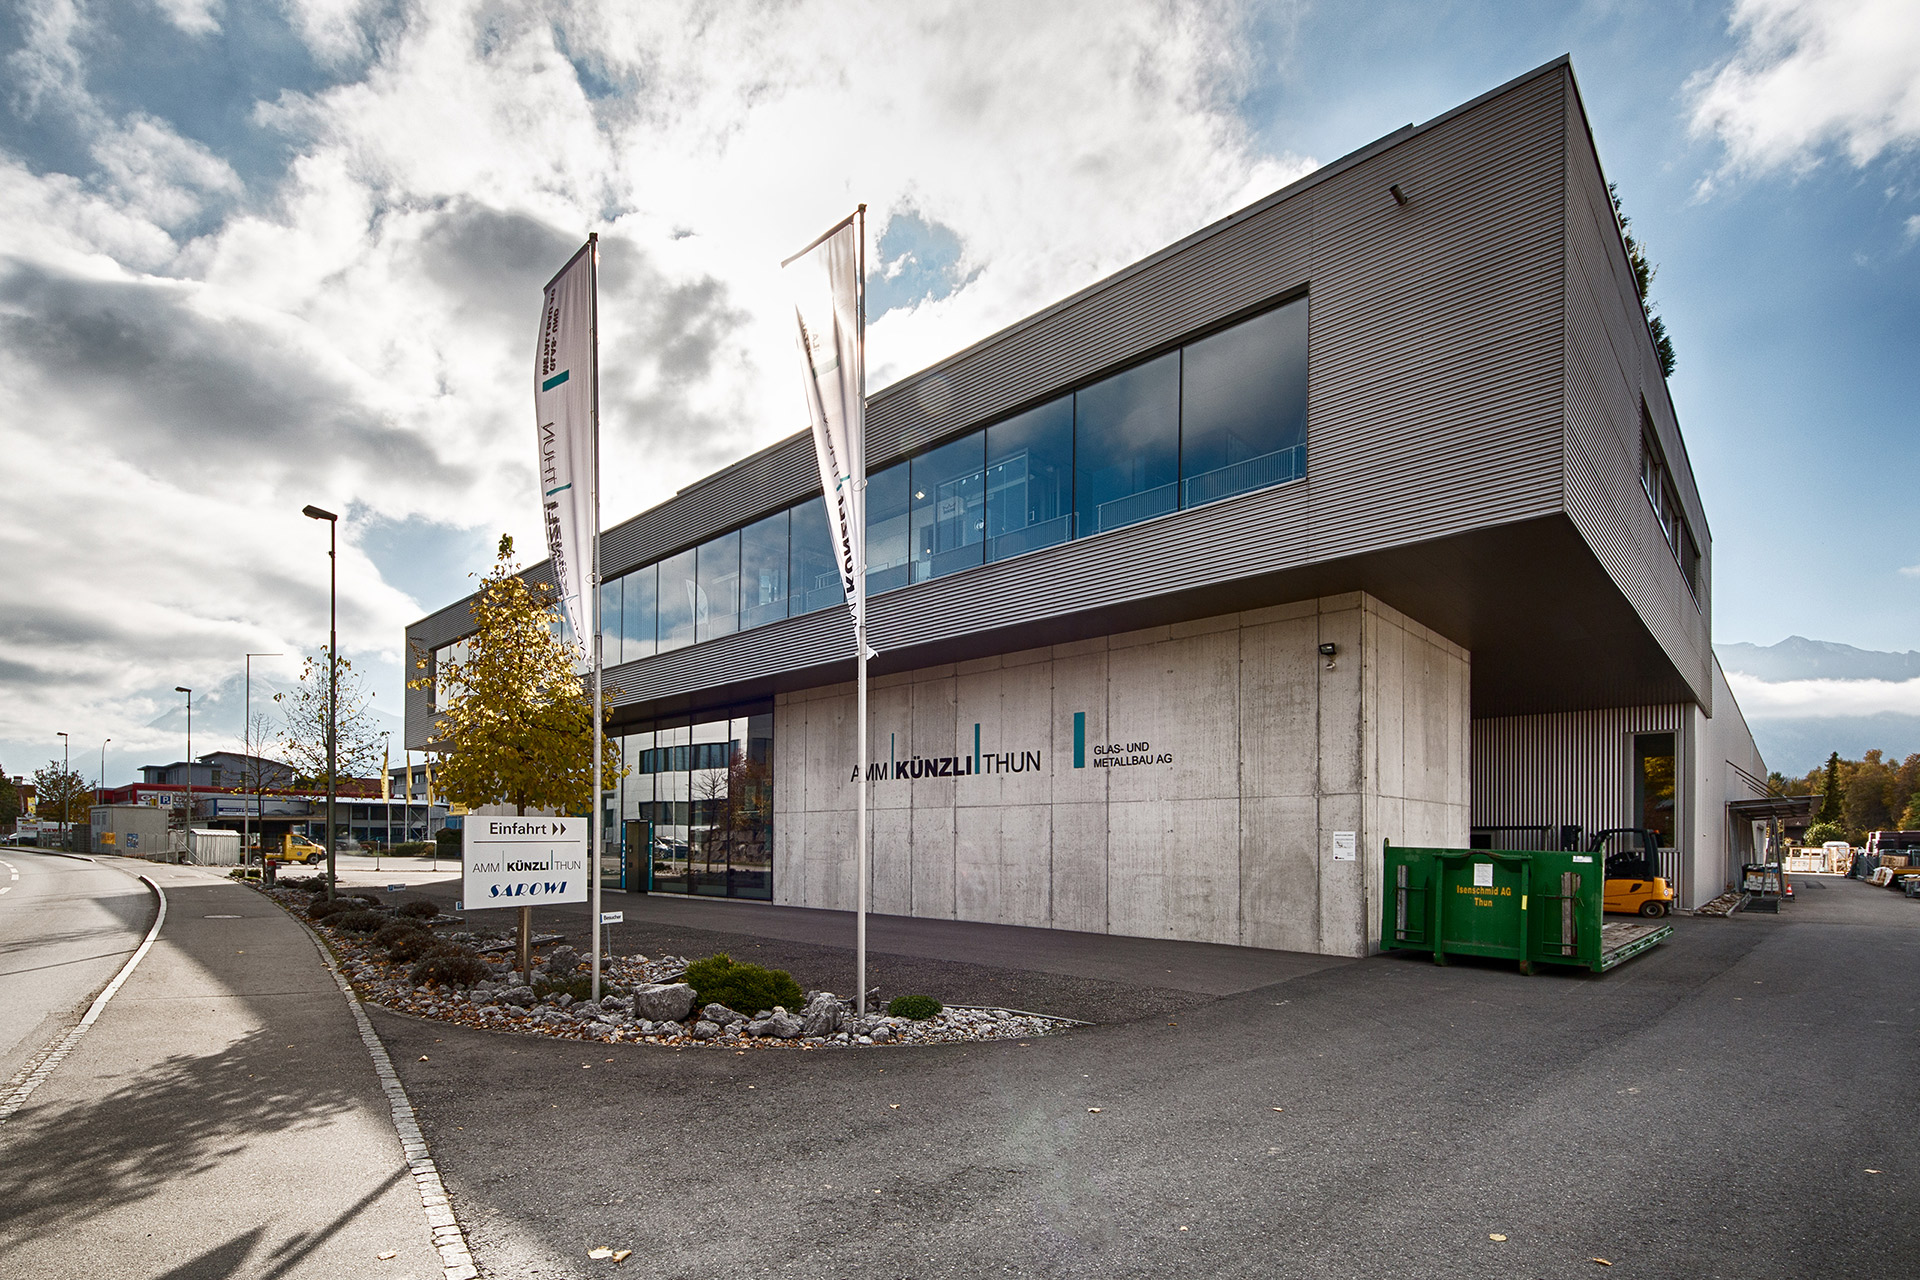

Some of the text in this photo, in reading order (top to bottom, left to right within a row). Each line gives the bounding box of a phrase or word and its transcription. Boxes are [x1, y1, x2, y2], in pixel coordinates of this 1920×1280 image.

[1093, 741, 1150, 755] GLAS- UND
[850, 750, 1041, 783] AMM KÜNZLI THUN
[1093, 753, 1173, 768] METALLBAU AG
[489, 822, 548, 835] Einfahrt
[472, 860, 582, 873] AMM KÜNZLI THUN
[488, 881, 568, 899] SAROWI
[1456, 885, 1512, 896] Isenschmid AG
[1474, 897, 1493, 907] Thun
